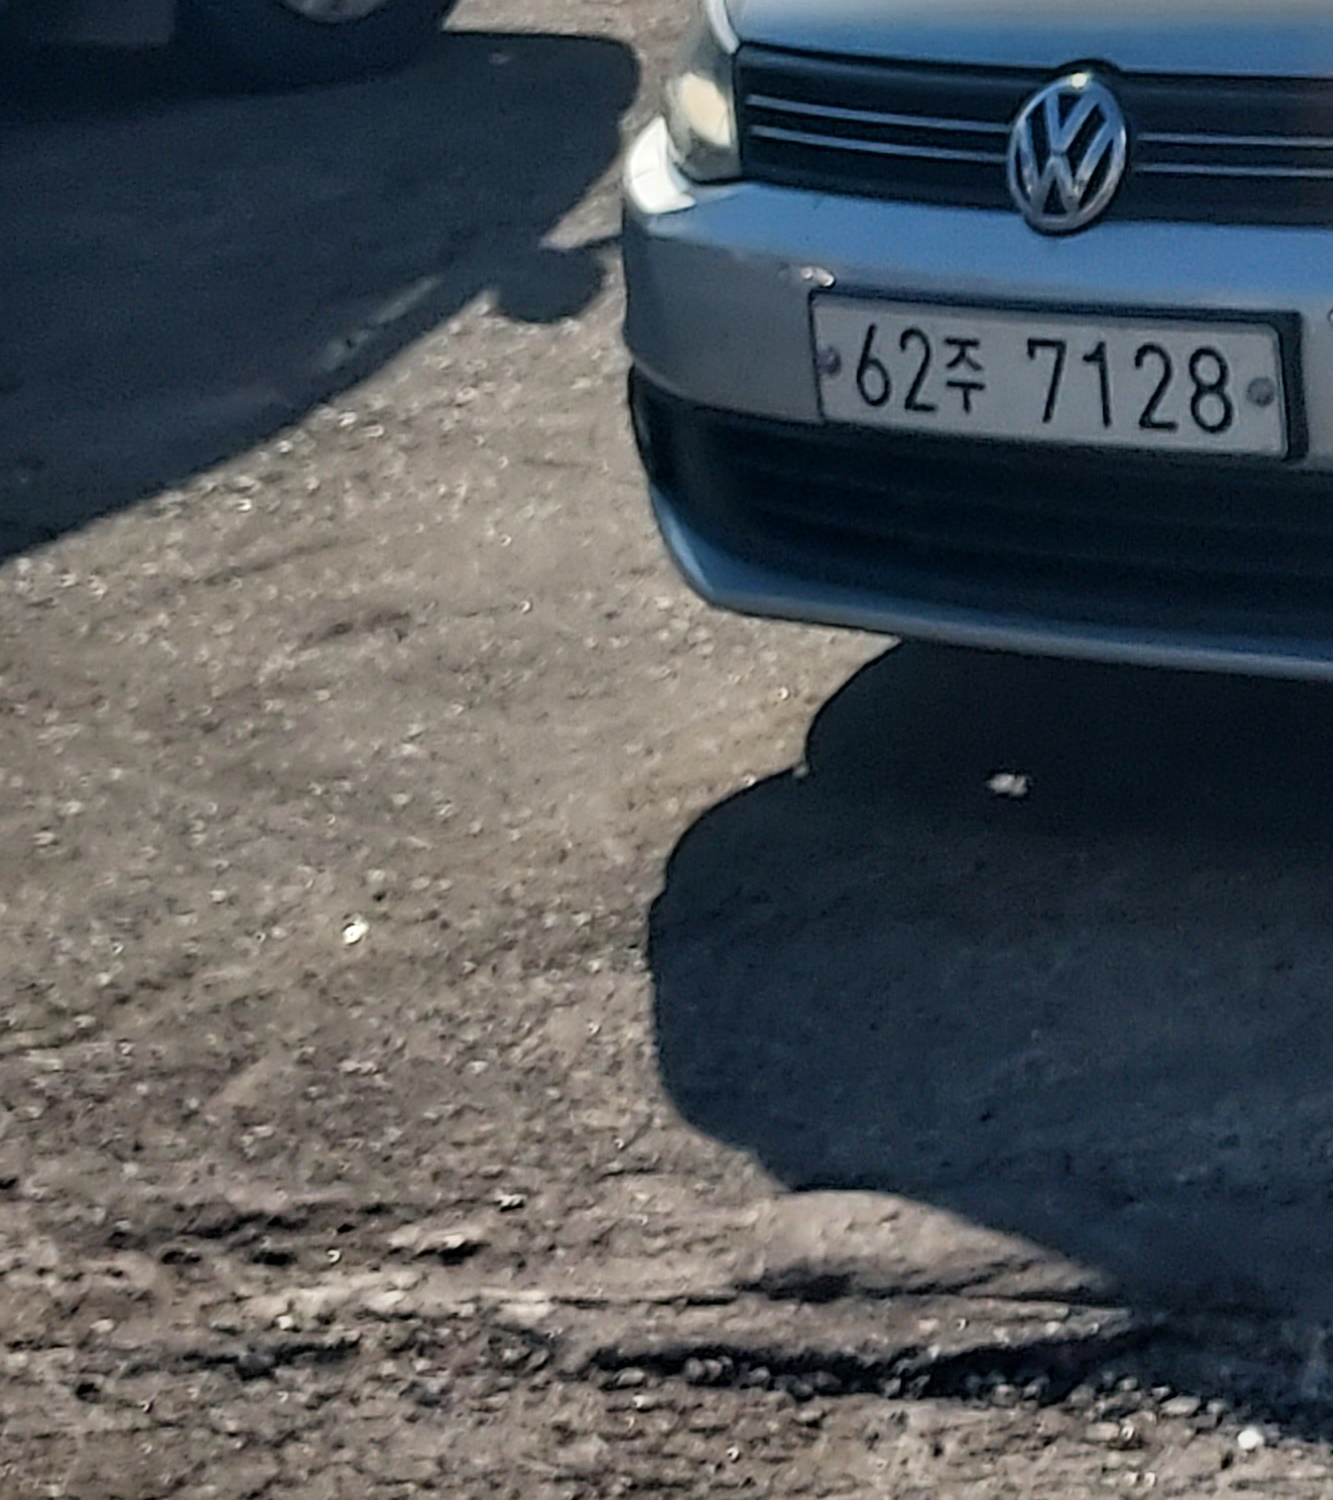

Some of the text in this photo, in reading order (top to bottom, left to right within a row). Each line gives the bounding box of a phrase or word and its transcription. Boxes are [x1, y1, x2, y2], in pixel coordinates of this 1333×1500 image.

[1008, 74, 1127, 231] VW
[856, 323, 1233, 434] 62주 7128
